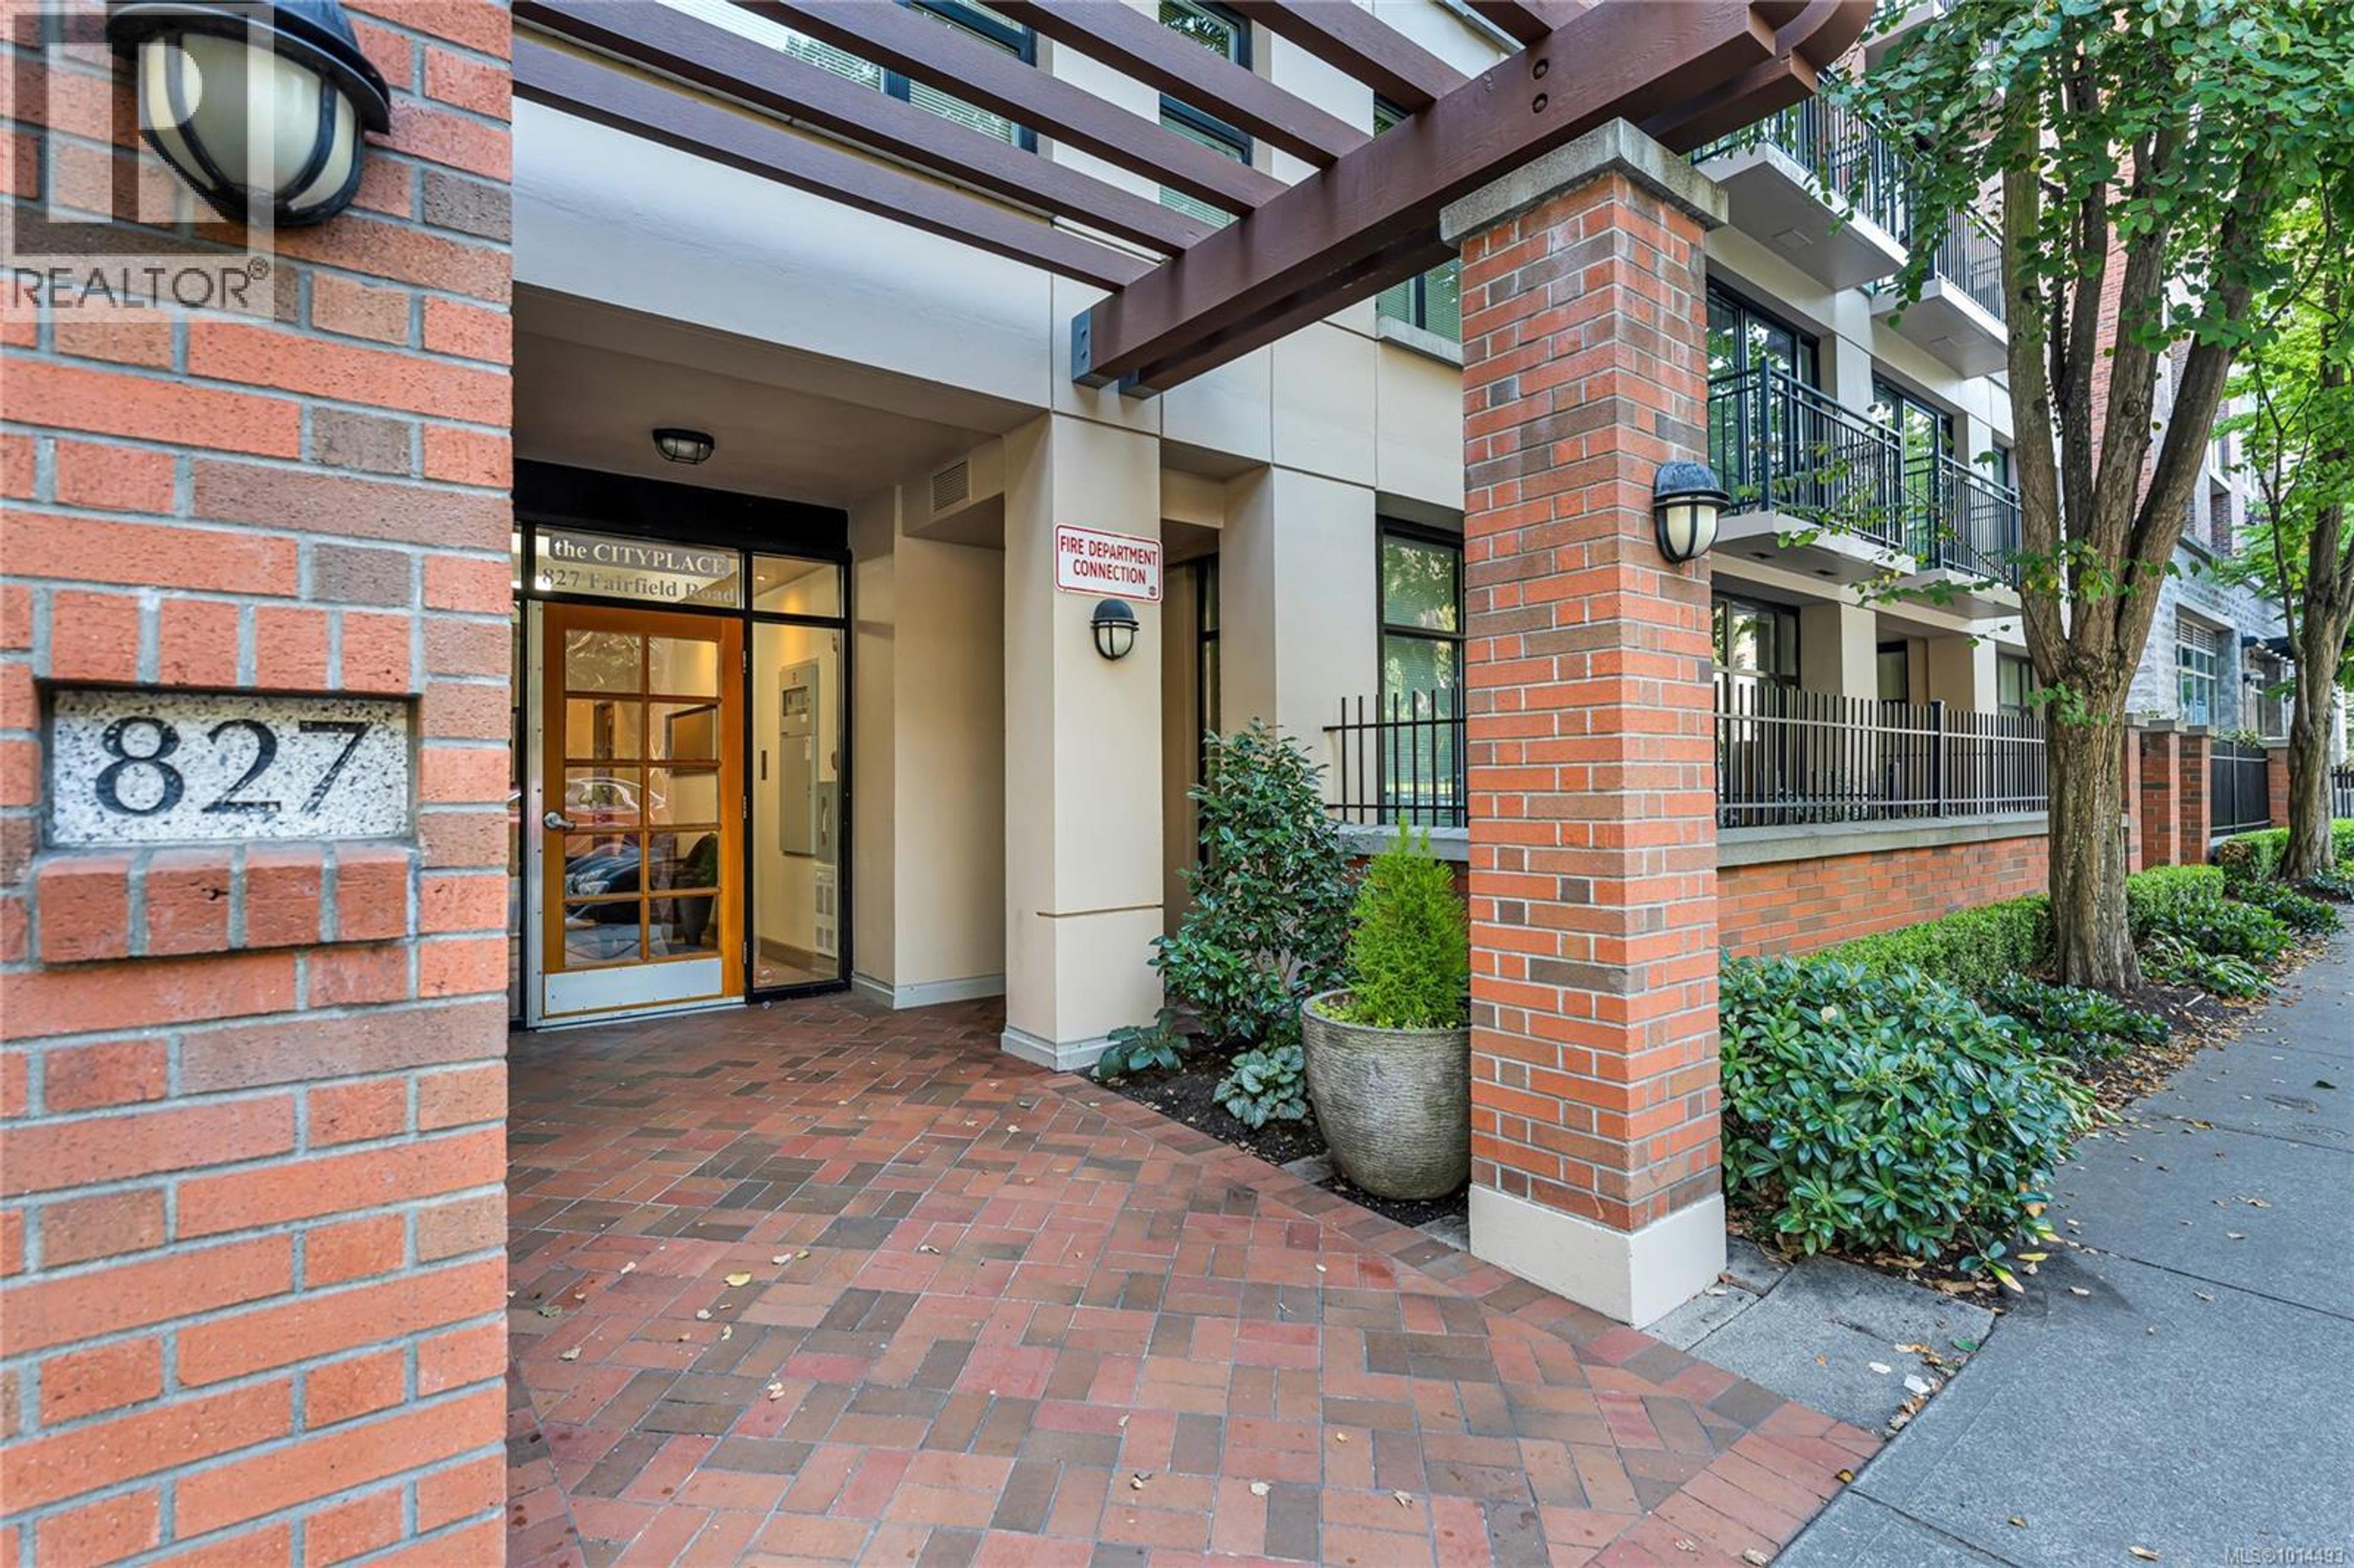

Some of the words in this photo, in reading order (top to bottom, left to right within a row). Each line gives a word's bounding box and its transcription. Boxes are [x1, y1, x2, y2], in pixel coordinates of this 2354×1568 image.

[553, 540, 586, 558] the
[592, 544, 726, 575] CITYPLACE
[1060, 535, 1084, 555] FIRE
[1088, 540, 1157, 565] DEPARTMENT
[542, 568, 579, 587] 827
[589, 573, 677, 596] Fairfield
[685, 583, 735, 602] Road
[1073, 558, 1146, 585] CONNECTION
[96, 715, 374, 818] 827
